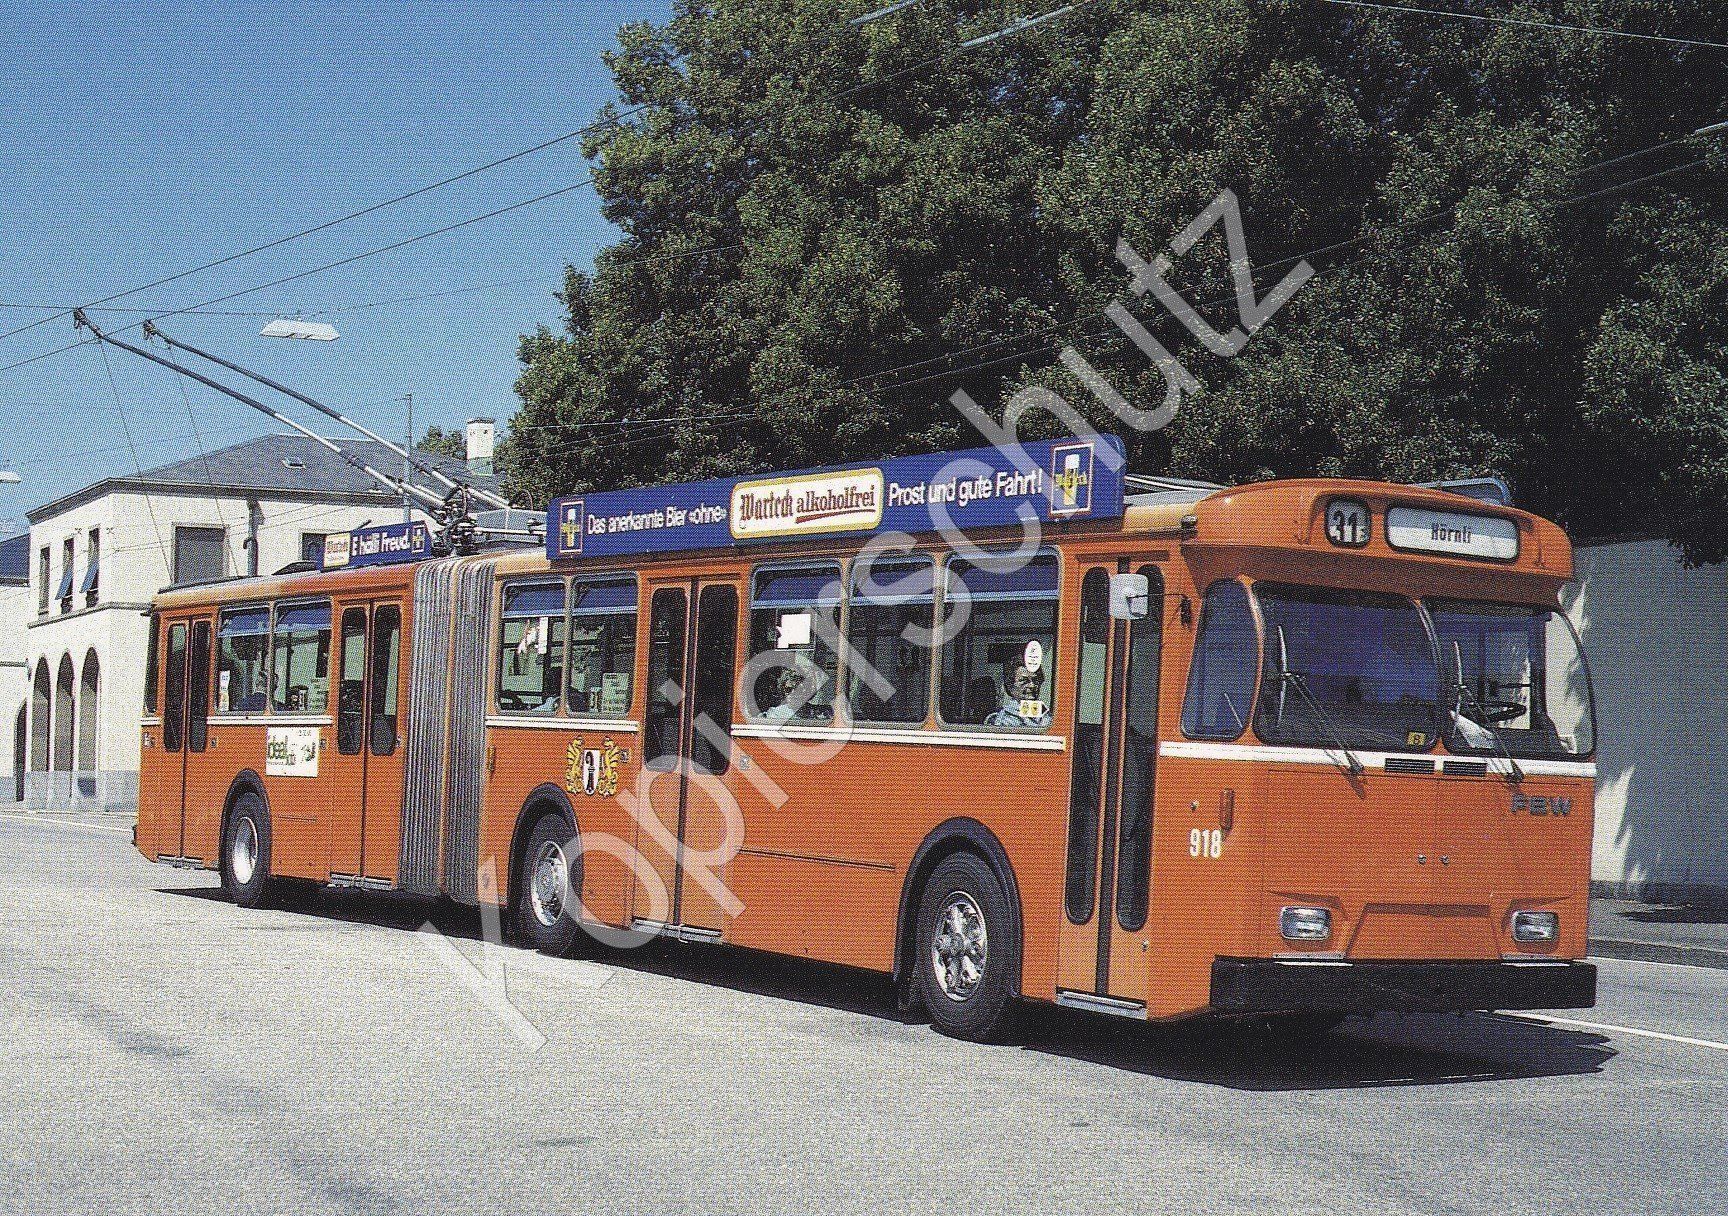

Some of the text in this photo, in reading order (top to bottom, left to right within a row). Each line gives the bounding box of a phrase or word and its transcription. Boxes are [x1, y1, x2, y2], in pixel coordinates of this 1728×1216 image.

[739, 484, 876, 521] Warteck alkoholfrei
[887, 468, 1044, 507] Prost und gute Fahrt!
[587, 512, 606, 535] Das
[607, 509, 664, 533] anerkannte
[665, 505, 688, 528] Bier
[1430, 521, 1472, 544] Hörnli
[1510, 792, 1573, 817] FBW
[1189, 827, 1222, 859] 918
